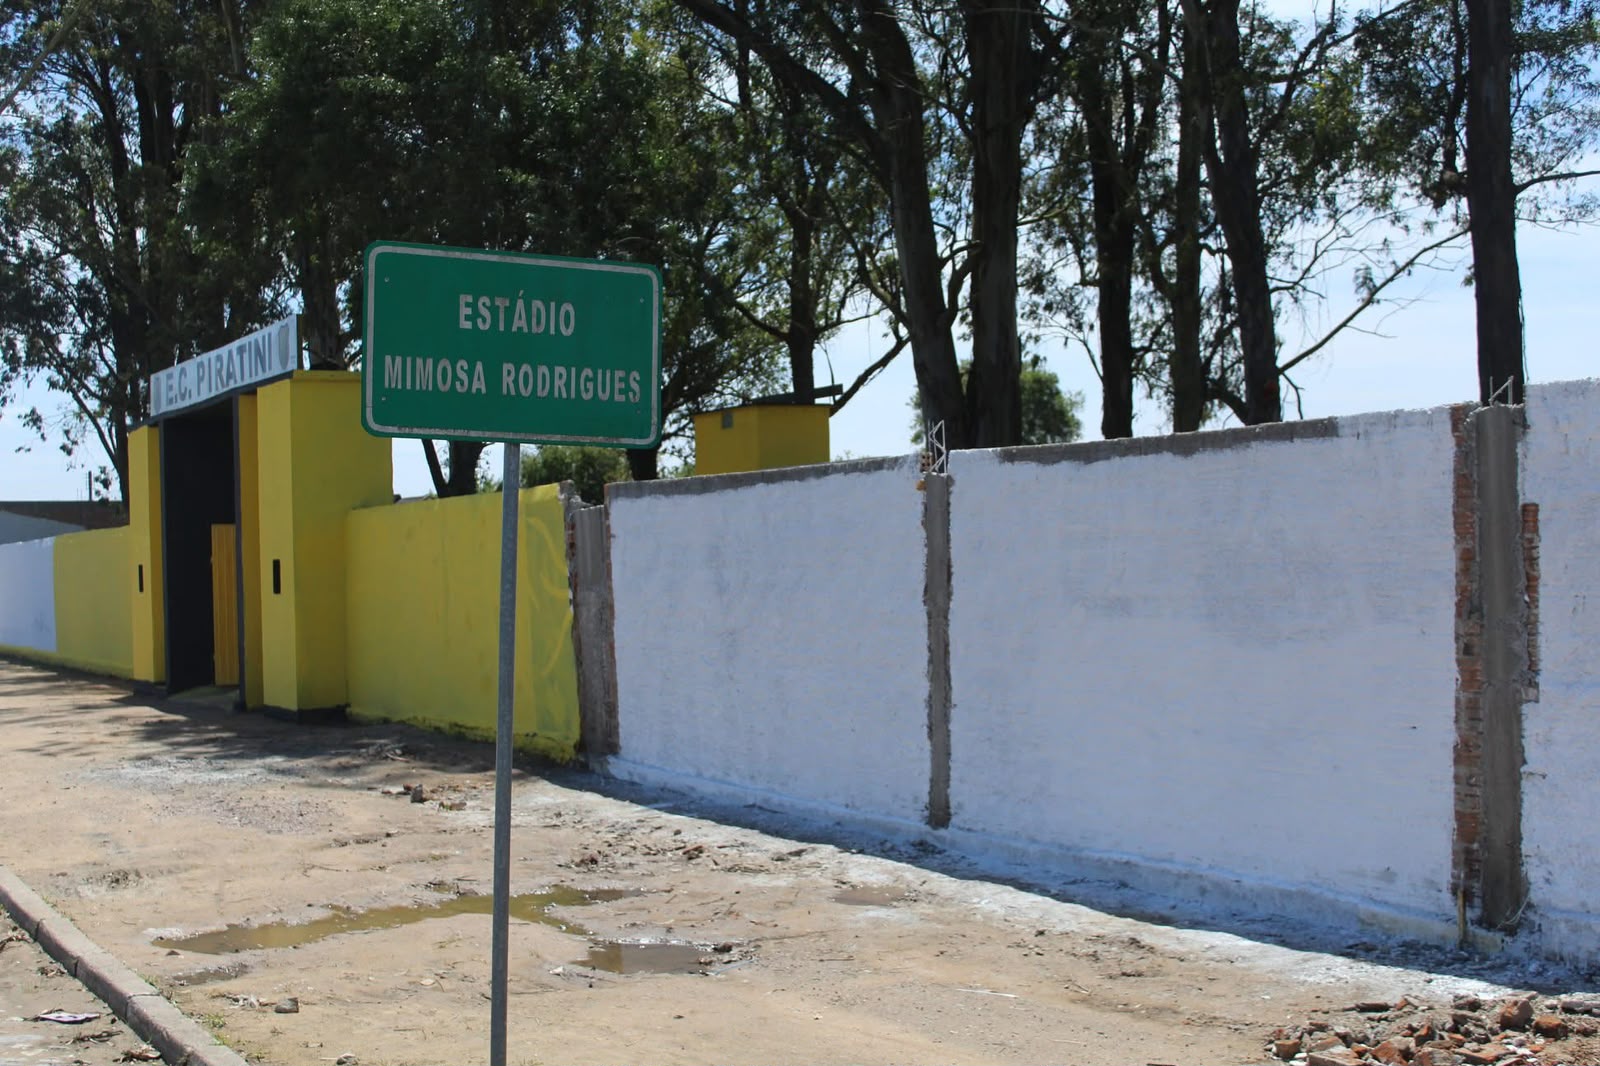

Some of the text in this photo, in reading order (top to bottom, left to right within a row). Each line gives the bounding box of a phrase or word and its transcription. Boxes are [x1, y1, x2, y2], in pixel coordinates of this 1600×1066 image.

[459, 290, 576, 337] ESTÁDIO
[166, 332, 272, 406] E.C. PIRATINI
[384, 354, 641, 403] MIMOSA RODRIGUES
